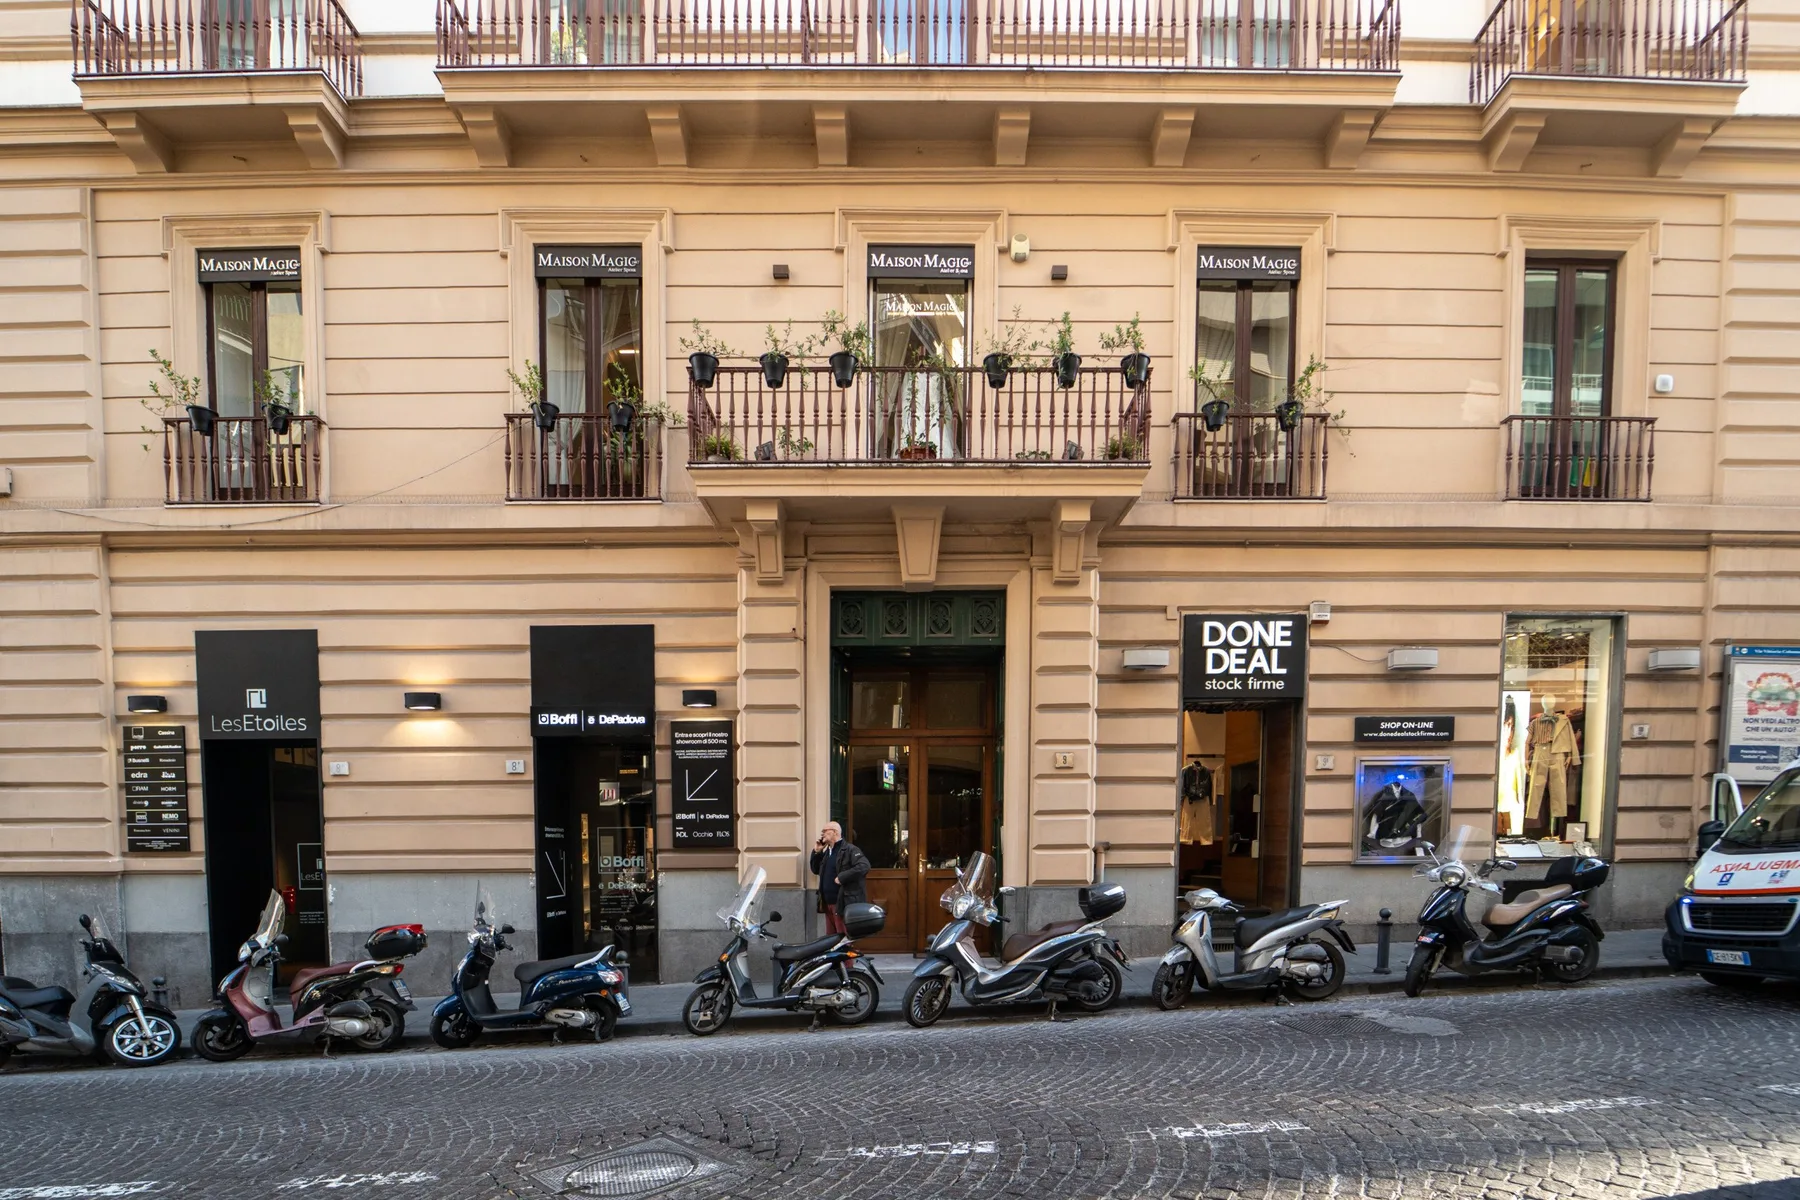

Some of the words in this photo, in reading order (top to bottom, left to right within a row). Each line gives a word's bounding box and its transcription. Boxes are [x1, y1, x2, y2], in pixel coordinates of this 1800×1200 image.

[200, 258, 251, 272] MAISON
[538, 253, 589, 267] MAISON
[871, 254, 922, 267] MAISON
[1200, 255, 1250, 269] MAISON
[886, 301, 922, 311] MAON
[1202, 621, 1292, 647] DONE
[1206, 648, 1287, 674] DEAL
[1205, 678, 1242, 690] stock
[1248, 677, 1285, 690] firme
[212, 715, 307, 732] LesEtoiles
[550, 714, 578, 724] Boffi
[599, 715, 646, 724] DePadova
[613, 856, 644, 867] Boffi
